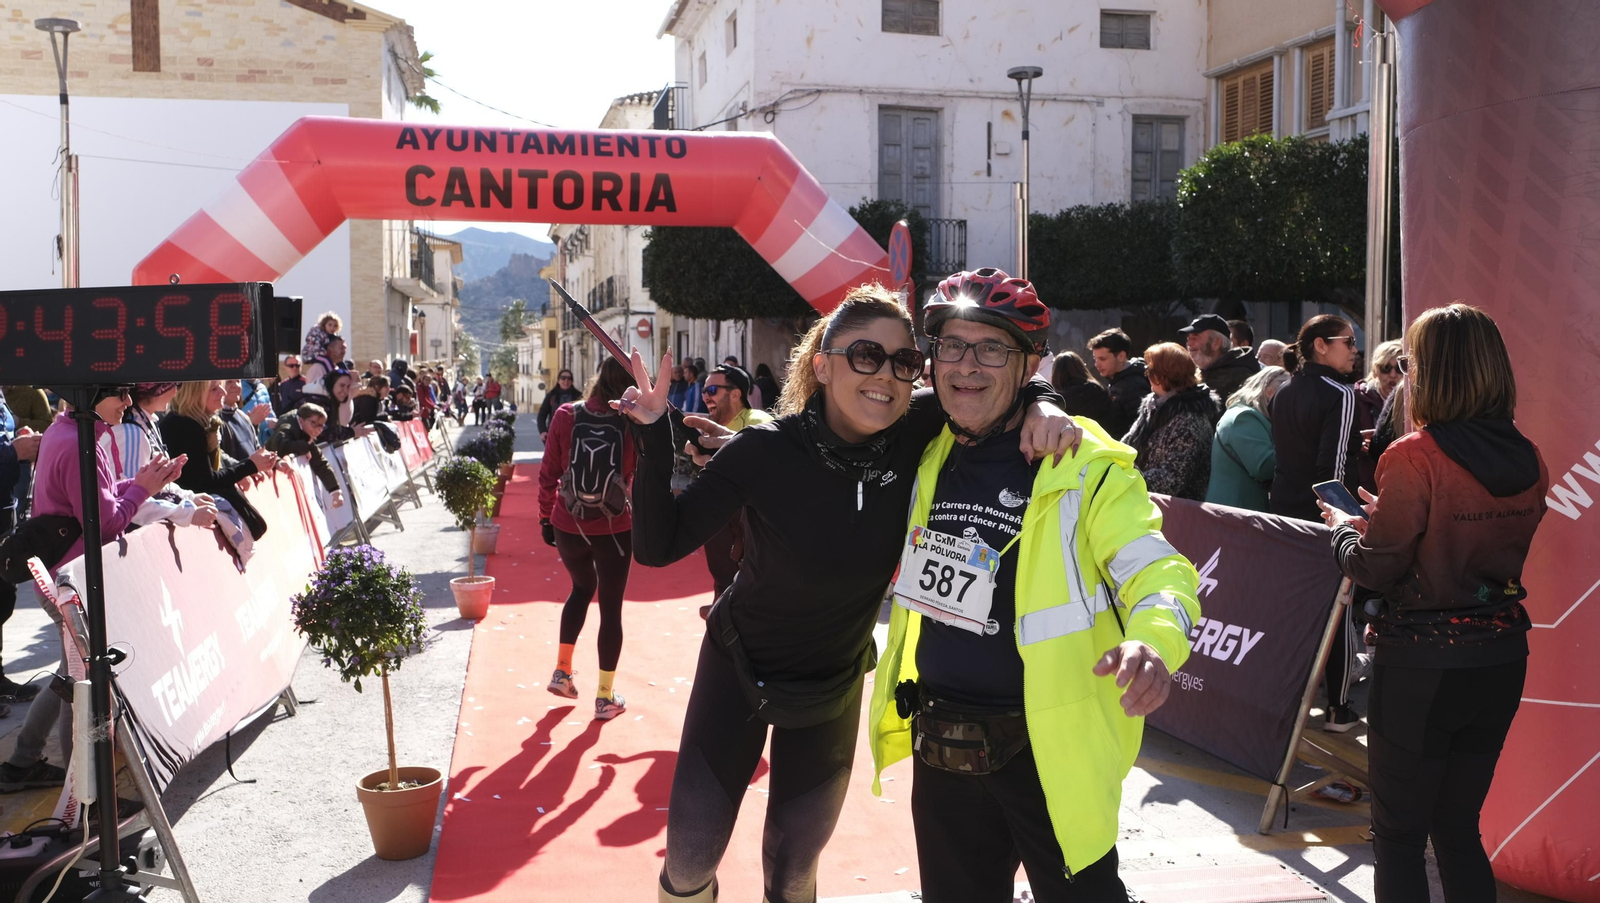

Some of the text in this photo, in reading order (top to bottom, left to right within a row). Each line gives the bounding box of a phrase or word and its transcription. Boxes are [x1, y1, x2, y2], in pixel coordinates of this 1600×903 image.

[396, 126, 687, 159] AYUNTAMIENTO
[405, 164, 677, 212] CANTORIA
[0, 292, 251, 373] :43:58
[941, 501, 971, 511] Carrera
[972, 503, 984, 513] de
[1453, 513, 1484, 521] VALLE
[1485, 511, 1494, 520] DE
[934, 513, 958, 521] contra
[968, 514, 997, 528] Cáncer
[935, 533, 956, 547] CxM
[930, 544, 967, 563] PÓLVORA
[918, 558, 978, 603] 587
[151, 631, 226, 728] TEAMERGY
